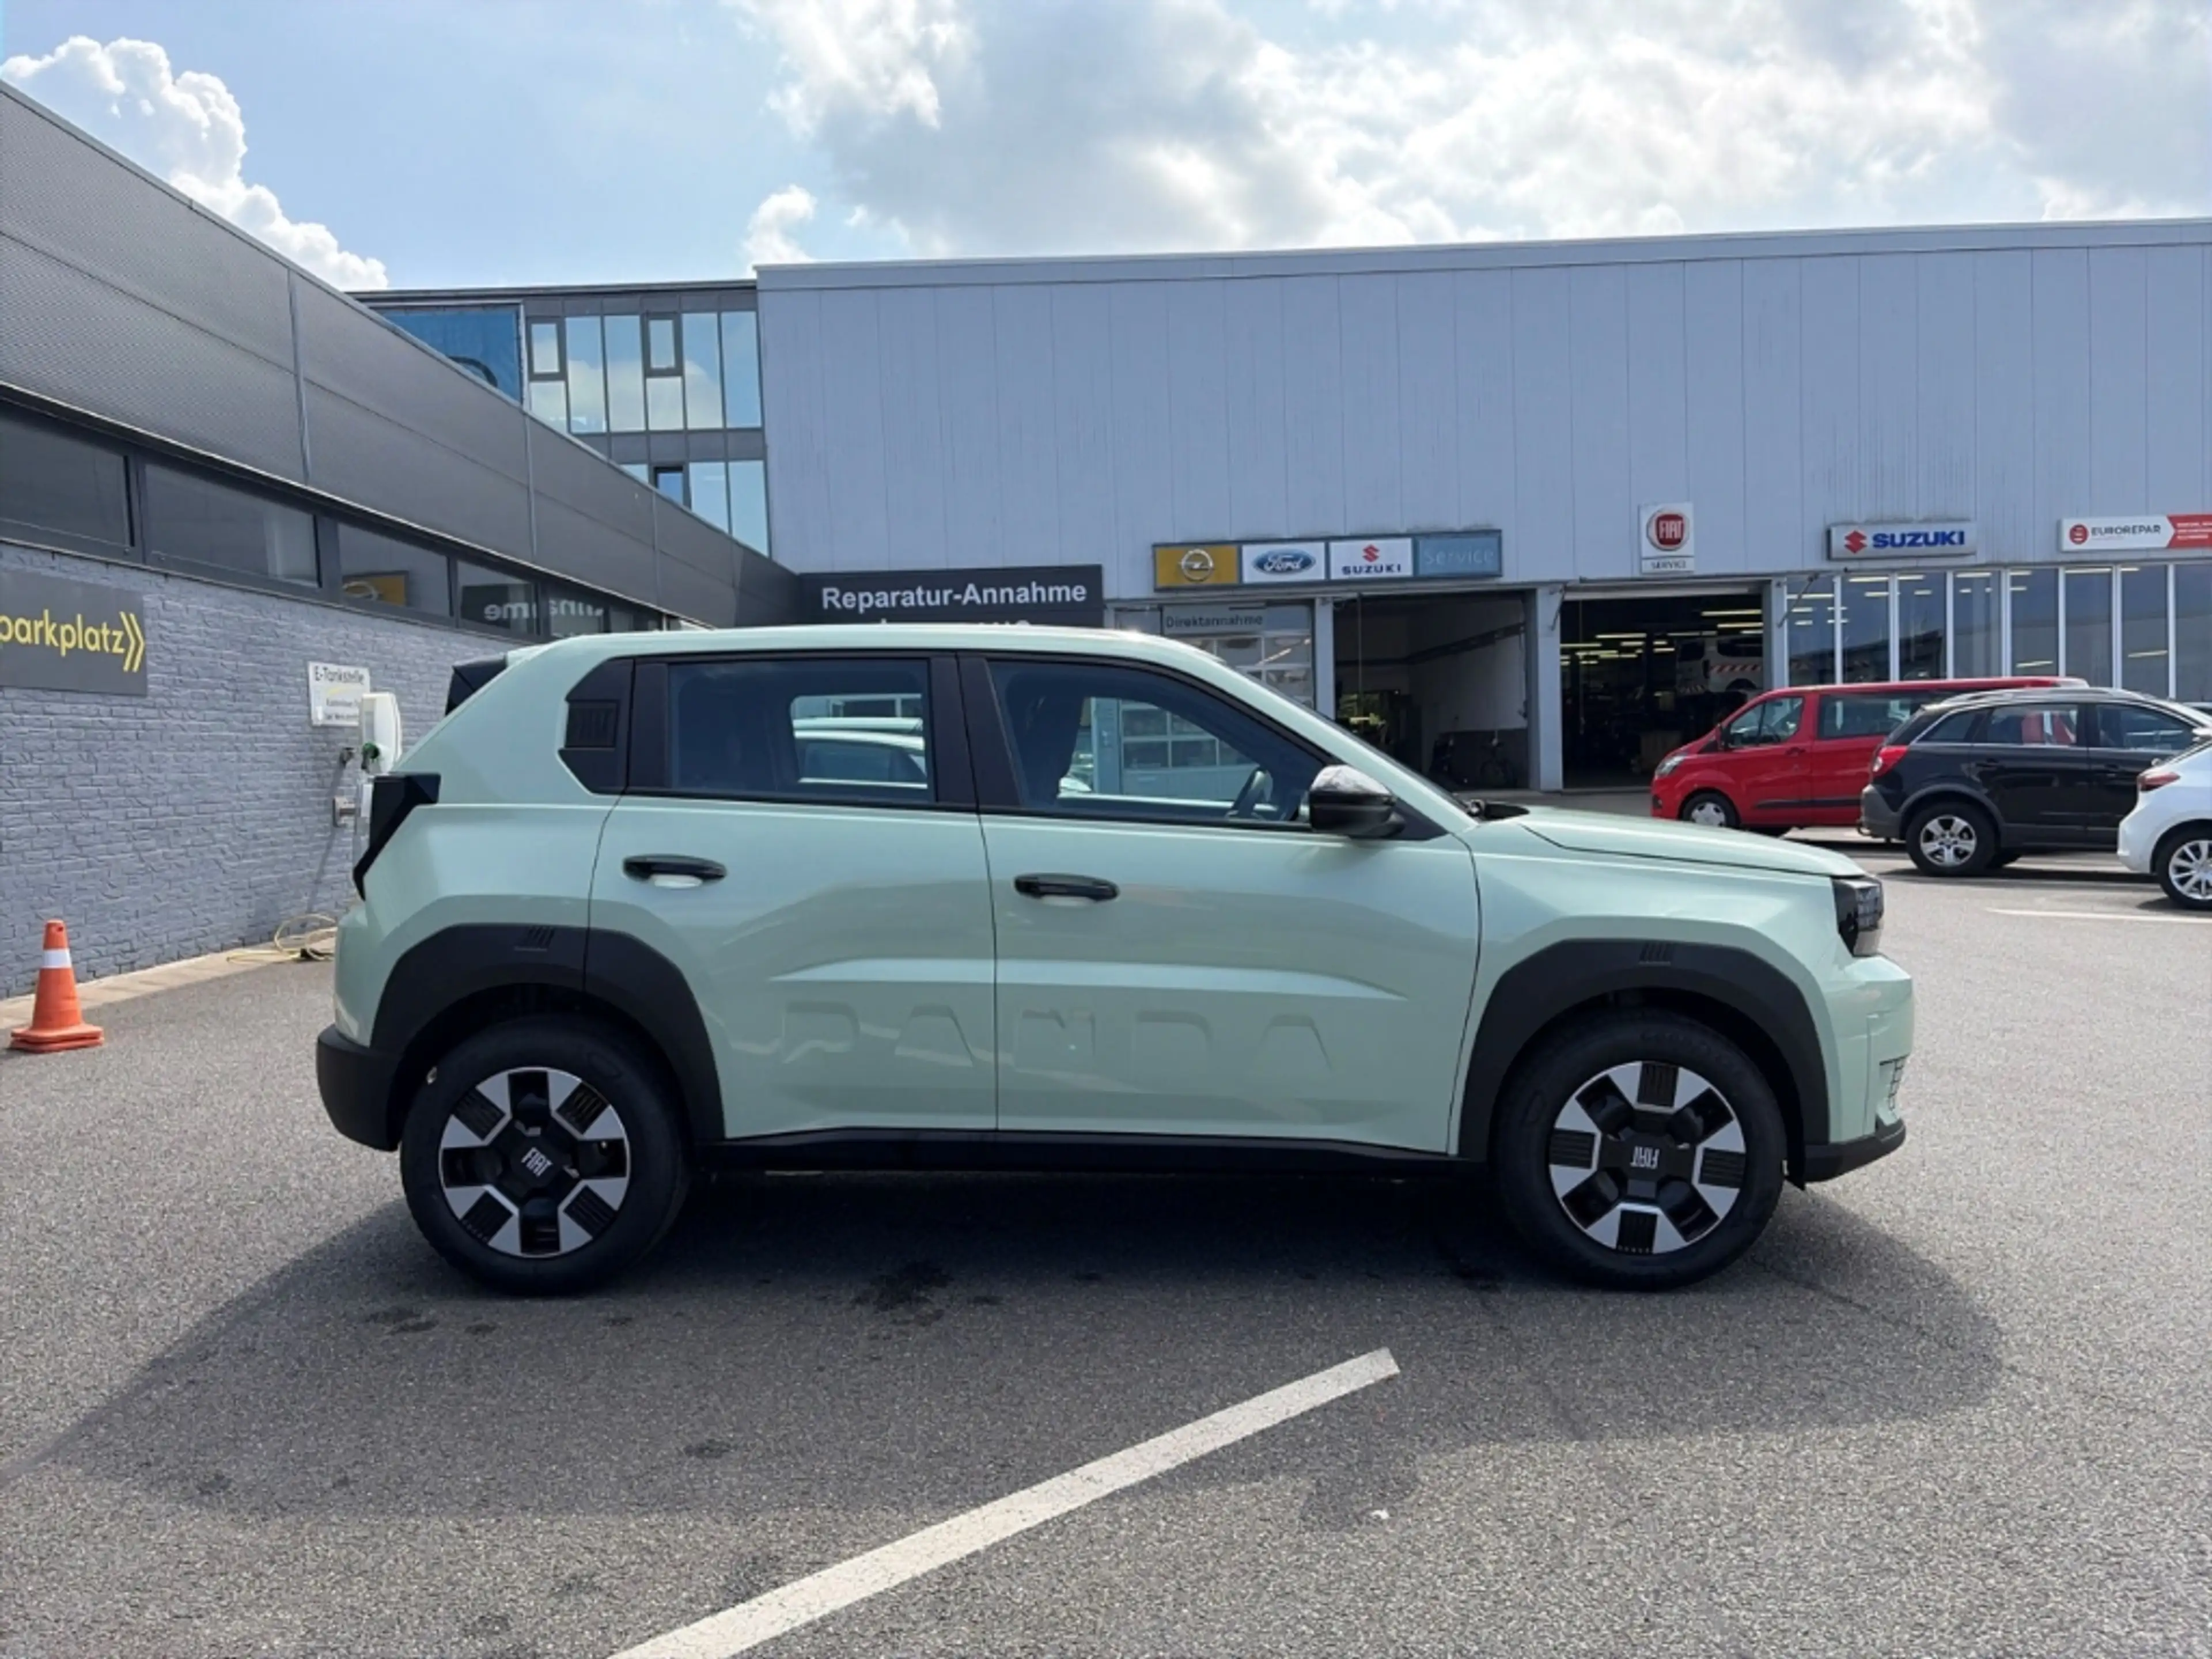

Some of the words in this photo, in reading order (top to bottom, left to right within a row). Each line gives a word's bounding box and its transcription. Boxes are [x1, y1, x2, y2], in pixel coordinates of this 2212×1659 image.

[1659, 520, 1681, 539] FIAT
[2092, 524, 2161, 536] EUROREPAR
[1872, 531, 1965, 548] SUZUKI
[1341, 564, 1402, 574] SUZUKI
[822, 581, 1087, 613] Reparatur-Annahme
[1166, 614, 1263, 627] Direktannahme
[783, 1001, 1335, 1071] PANDA
[521, 1146, 553, 1177] FIAT
[1630, 1146, 1660, 1169] FIAT
